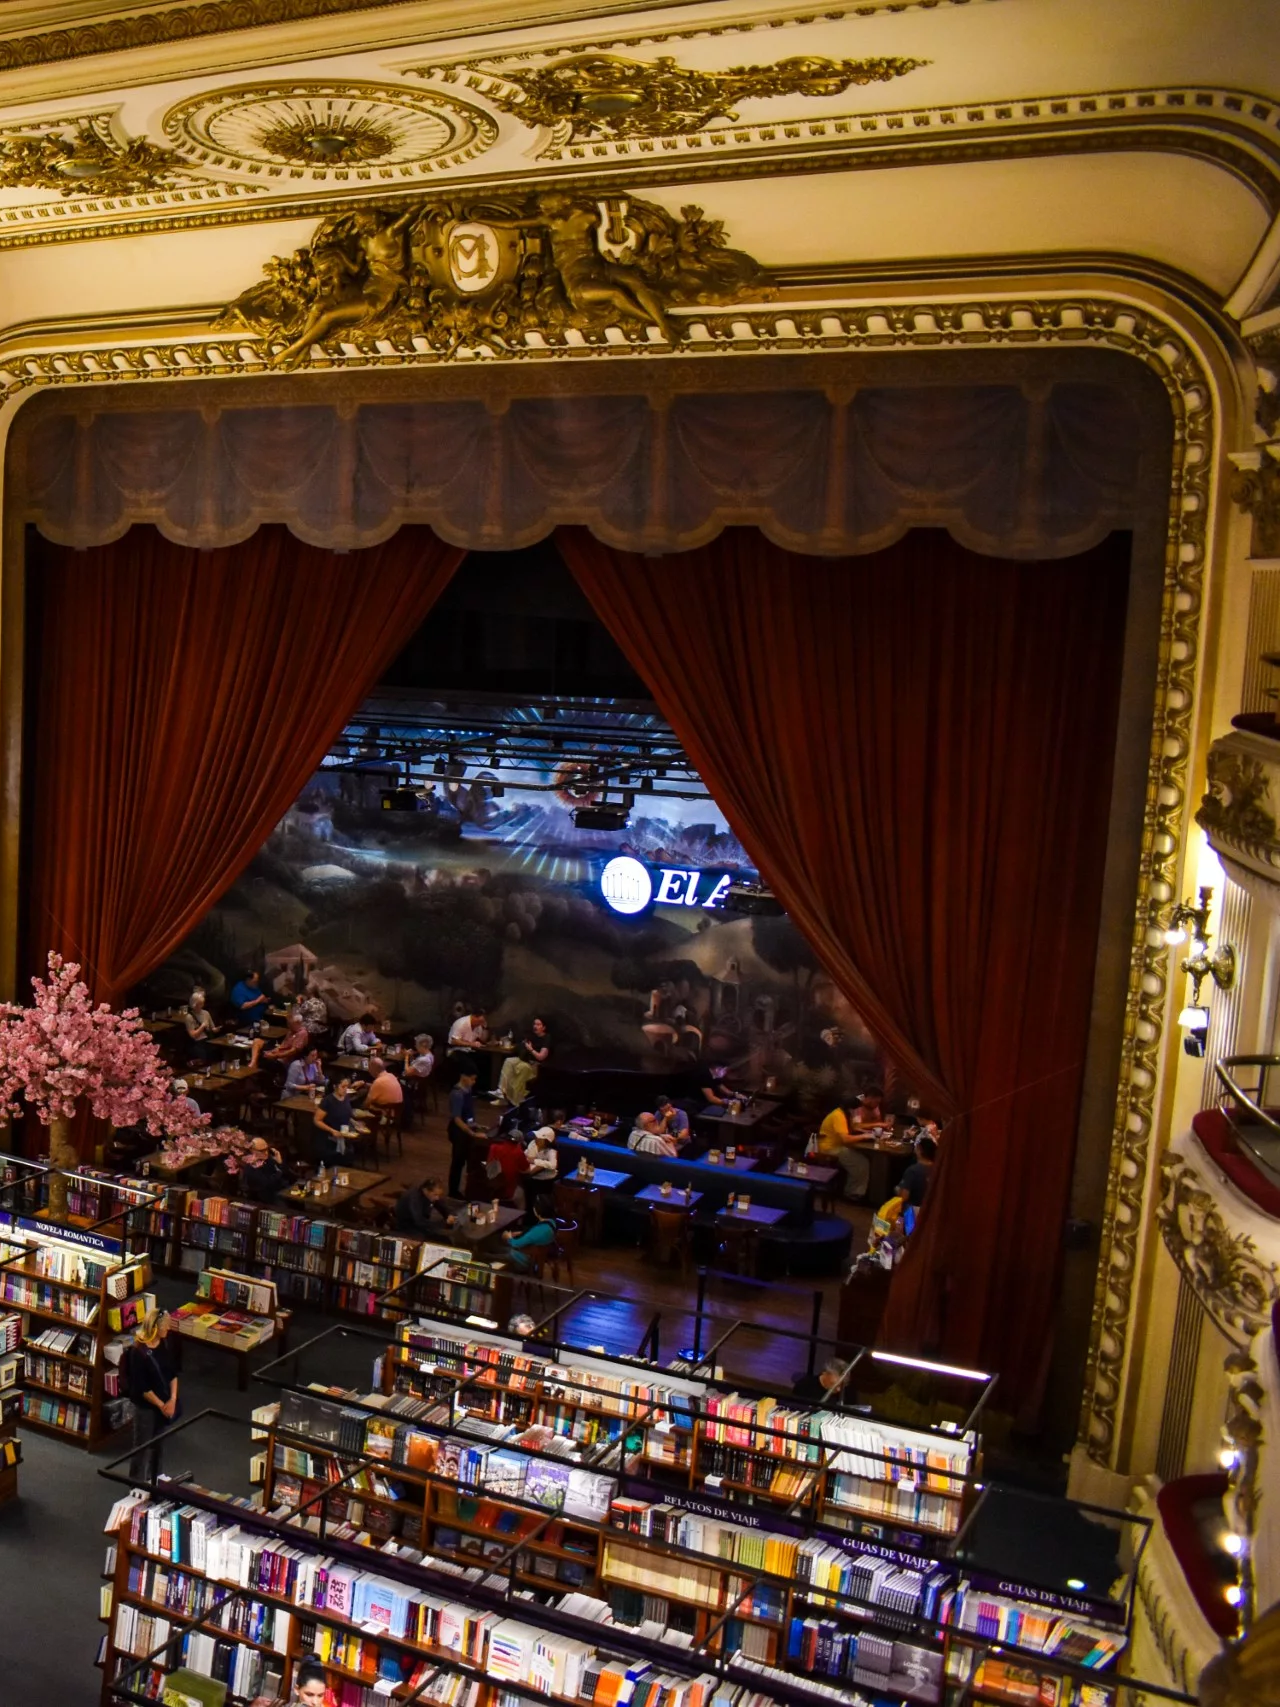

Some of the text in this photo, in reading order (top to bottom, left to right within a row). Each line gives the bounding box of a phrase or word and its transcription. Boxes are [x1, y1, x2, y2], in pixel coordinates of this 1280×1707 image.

[653, 868, 701, 906] El
[35, 1221, 63, 1236] NOVELA
[663, 1494, 760, 1527] RELATOS DE VIAJE
[880, 1547, 896, 1560] DE
[898, 1551, 929, 1569] VIAJE
[1040, 1591, 1057, 1603] DE
[1059, 1595, 1093, 1612] VIAJE
